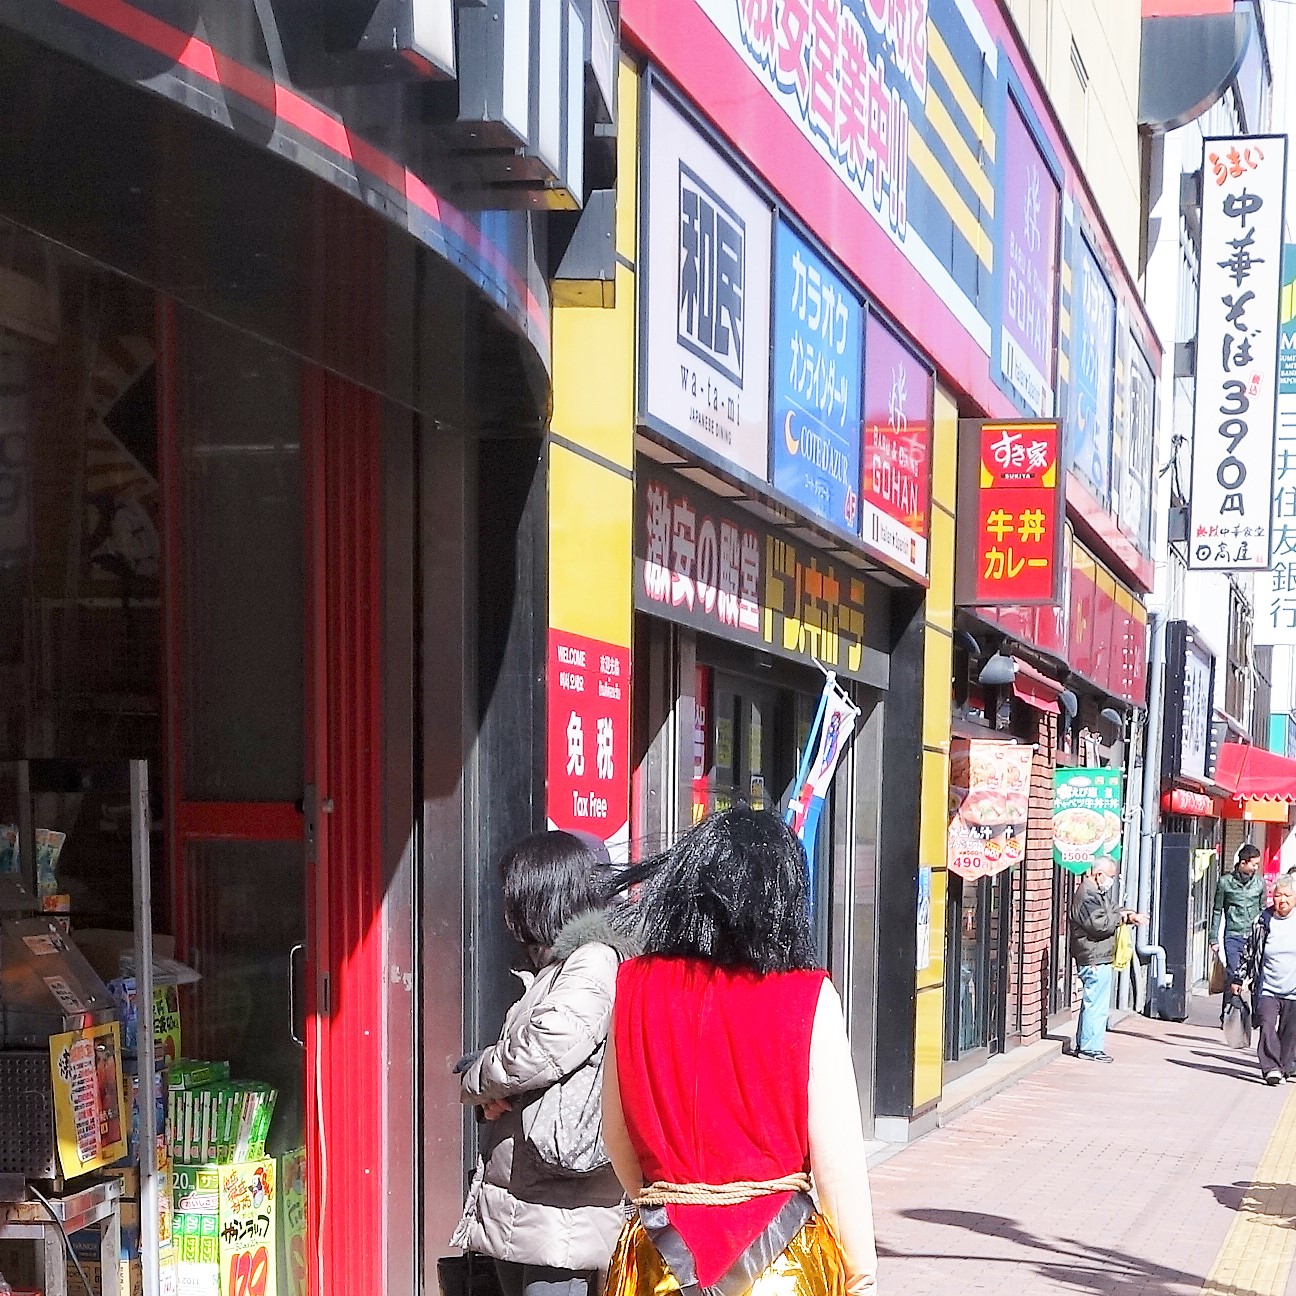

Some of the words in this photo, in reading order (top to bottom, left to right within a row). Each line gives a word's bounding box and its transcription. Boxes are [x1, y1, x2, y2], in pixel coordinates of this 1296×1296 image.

[1208, 145, 1265, 187] うまい
[680, 180, 744, 383] 和民
[791, 250, 849, 356] カラオケ
[990, 430, 1049, 472] すき家
[872, 454, 919, 519] GOHAN
[984, 508, 1046, 543] 牛丼
[644, 480, 761, 633] 激安の殿堂
[984, 546, 1048, 580] カレー
[557, 644, 587, 668] WELCOME
[566, 710, 614, 780] 免税
[572, 790, 589, 818] Tax
[589, 791, 608, 819] Free
